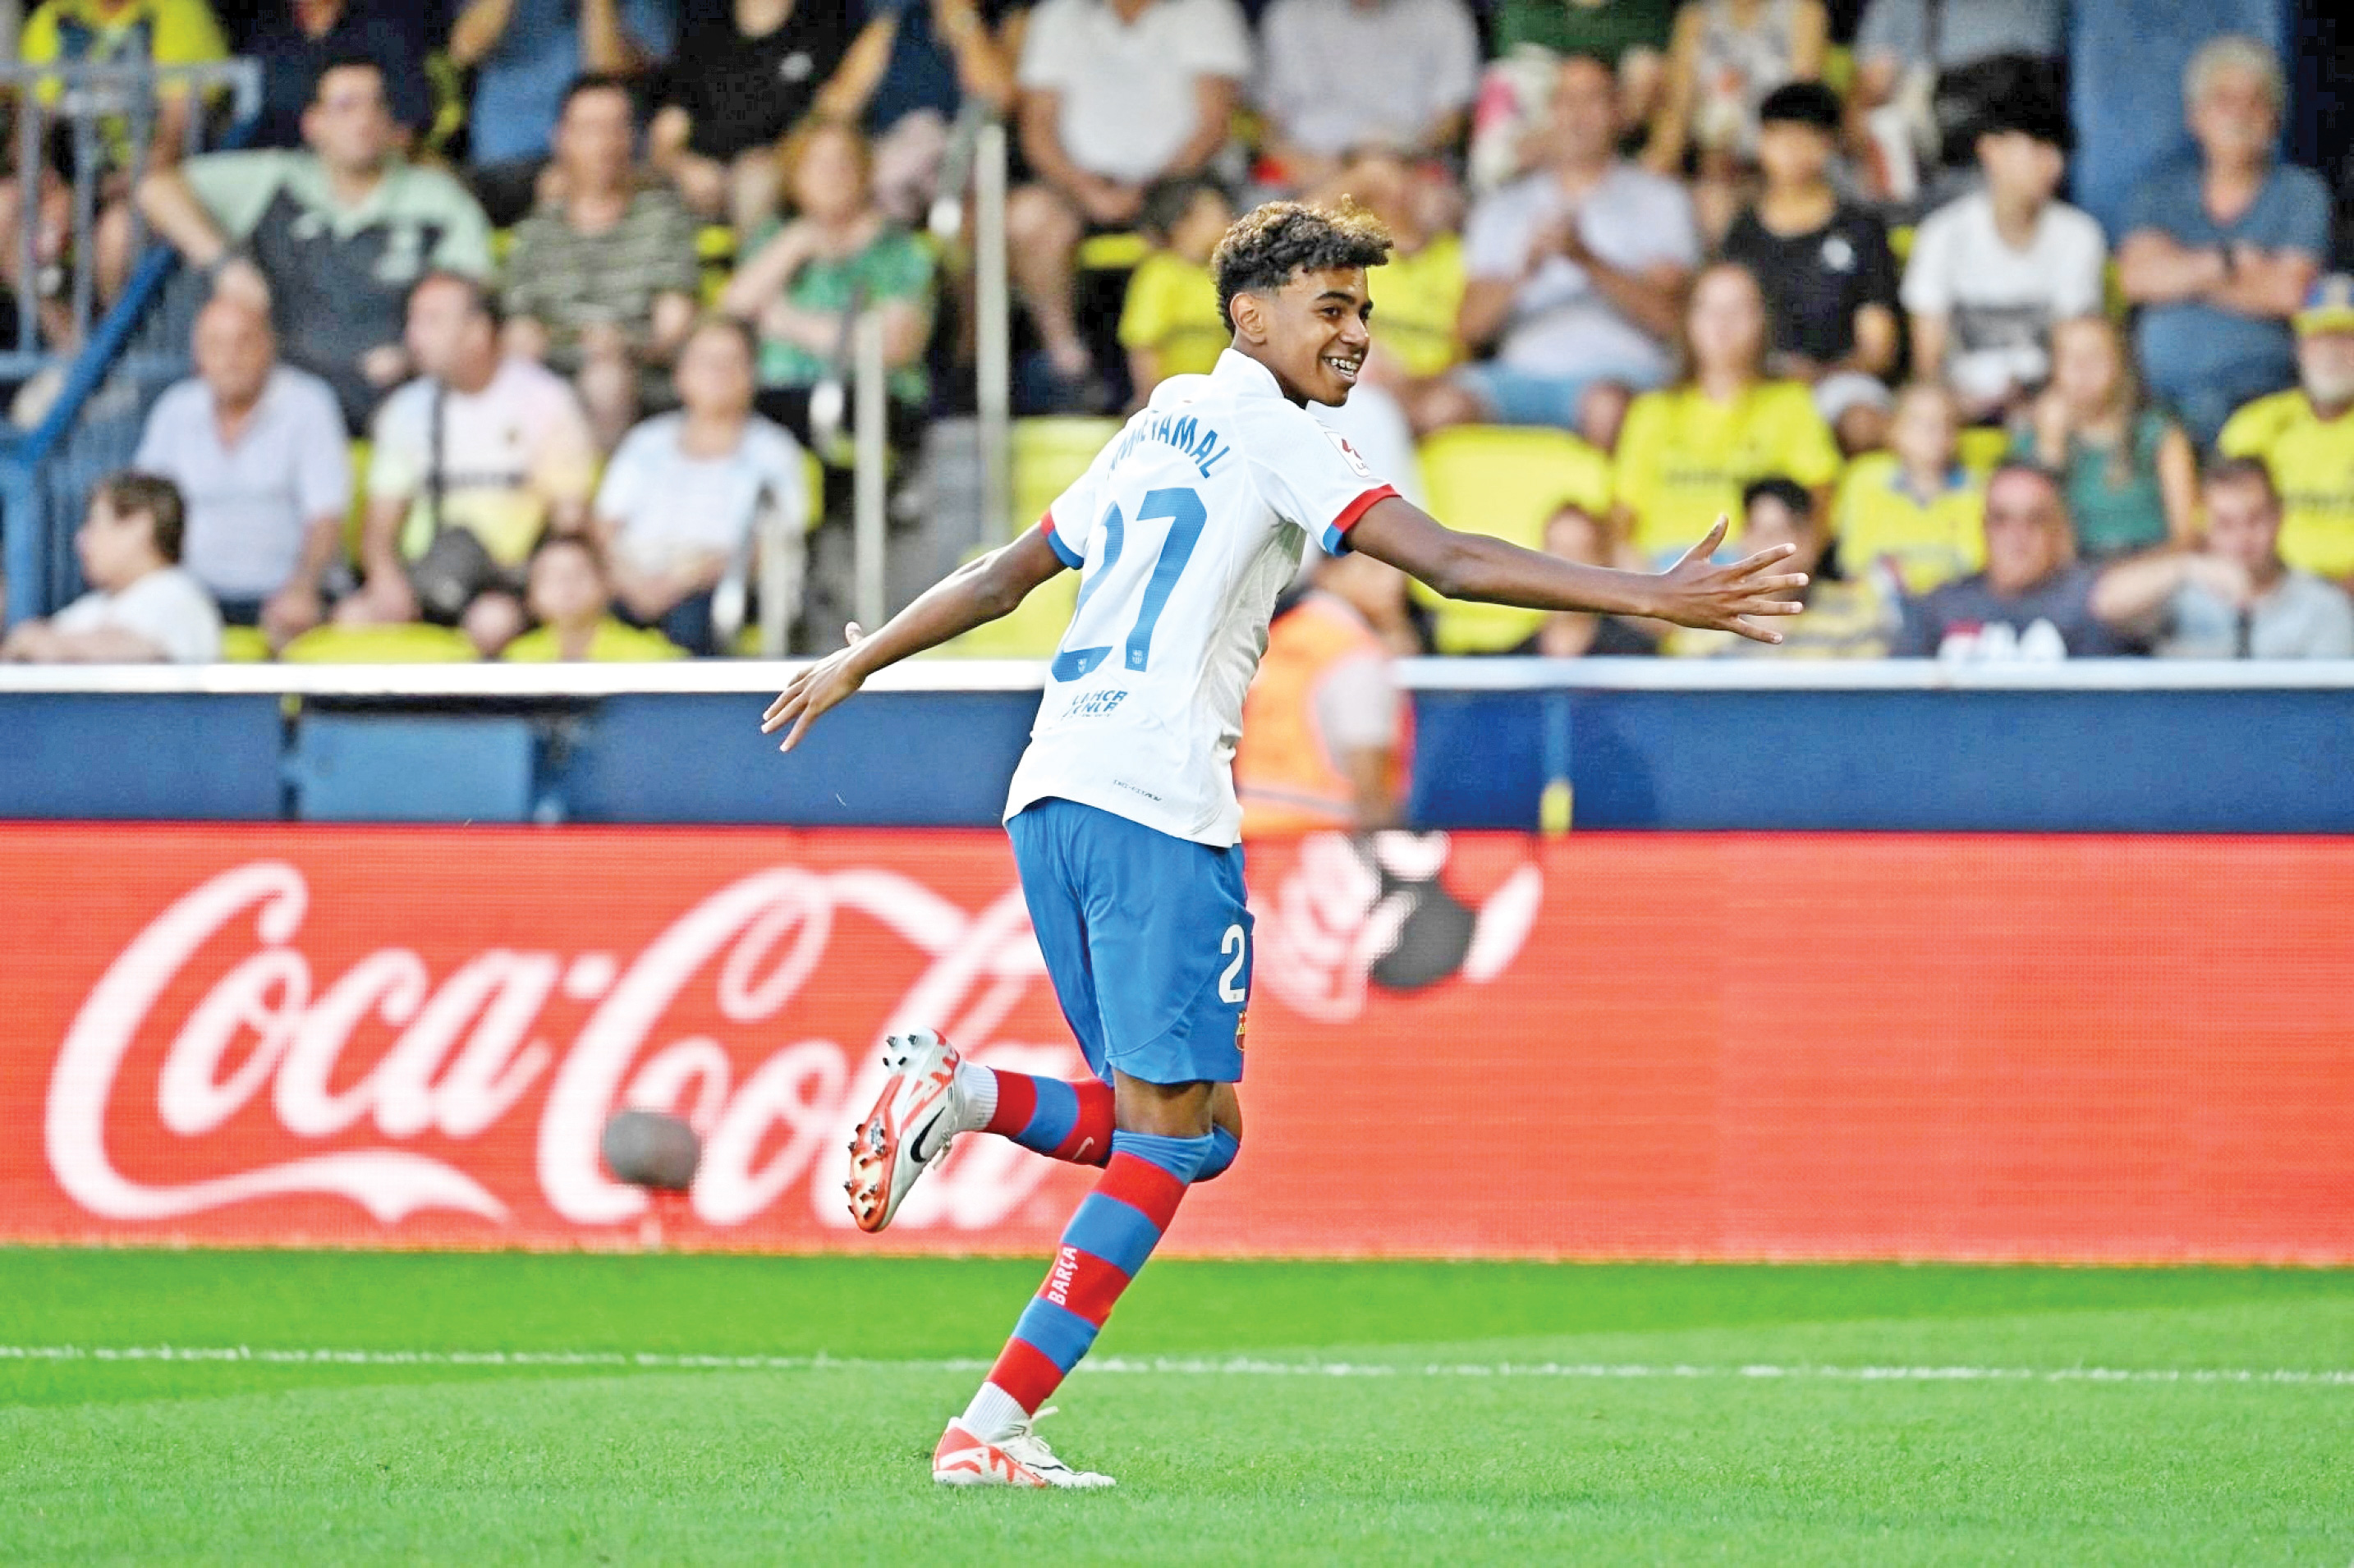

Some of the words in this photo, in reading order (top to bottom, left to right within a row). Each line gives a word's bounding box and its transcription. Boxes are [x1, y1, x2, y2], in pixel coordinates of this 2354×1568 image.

[1052, 487, 1207, 683] 27
[1218, 924, 1246, 1003] 2
[44, 860, 1076, 1231] Coca-Cola
[1048, 1247, 1078, 1305] BARÇA
